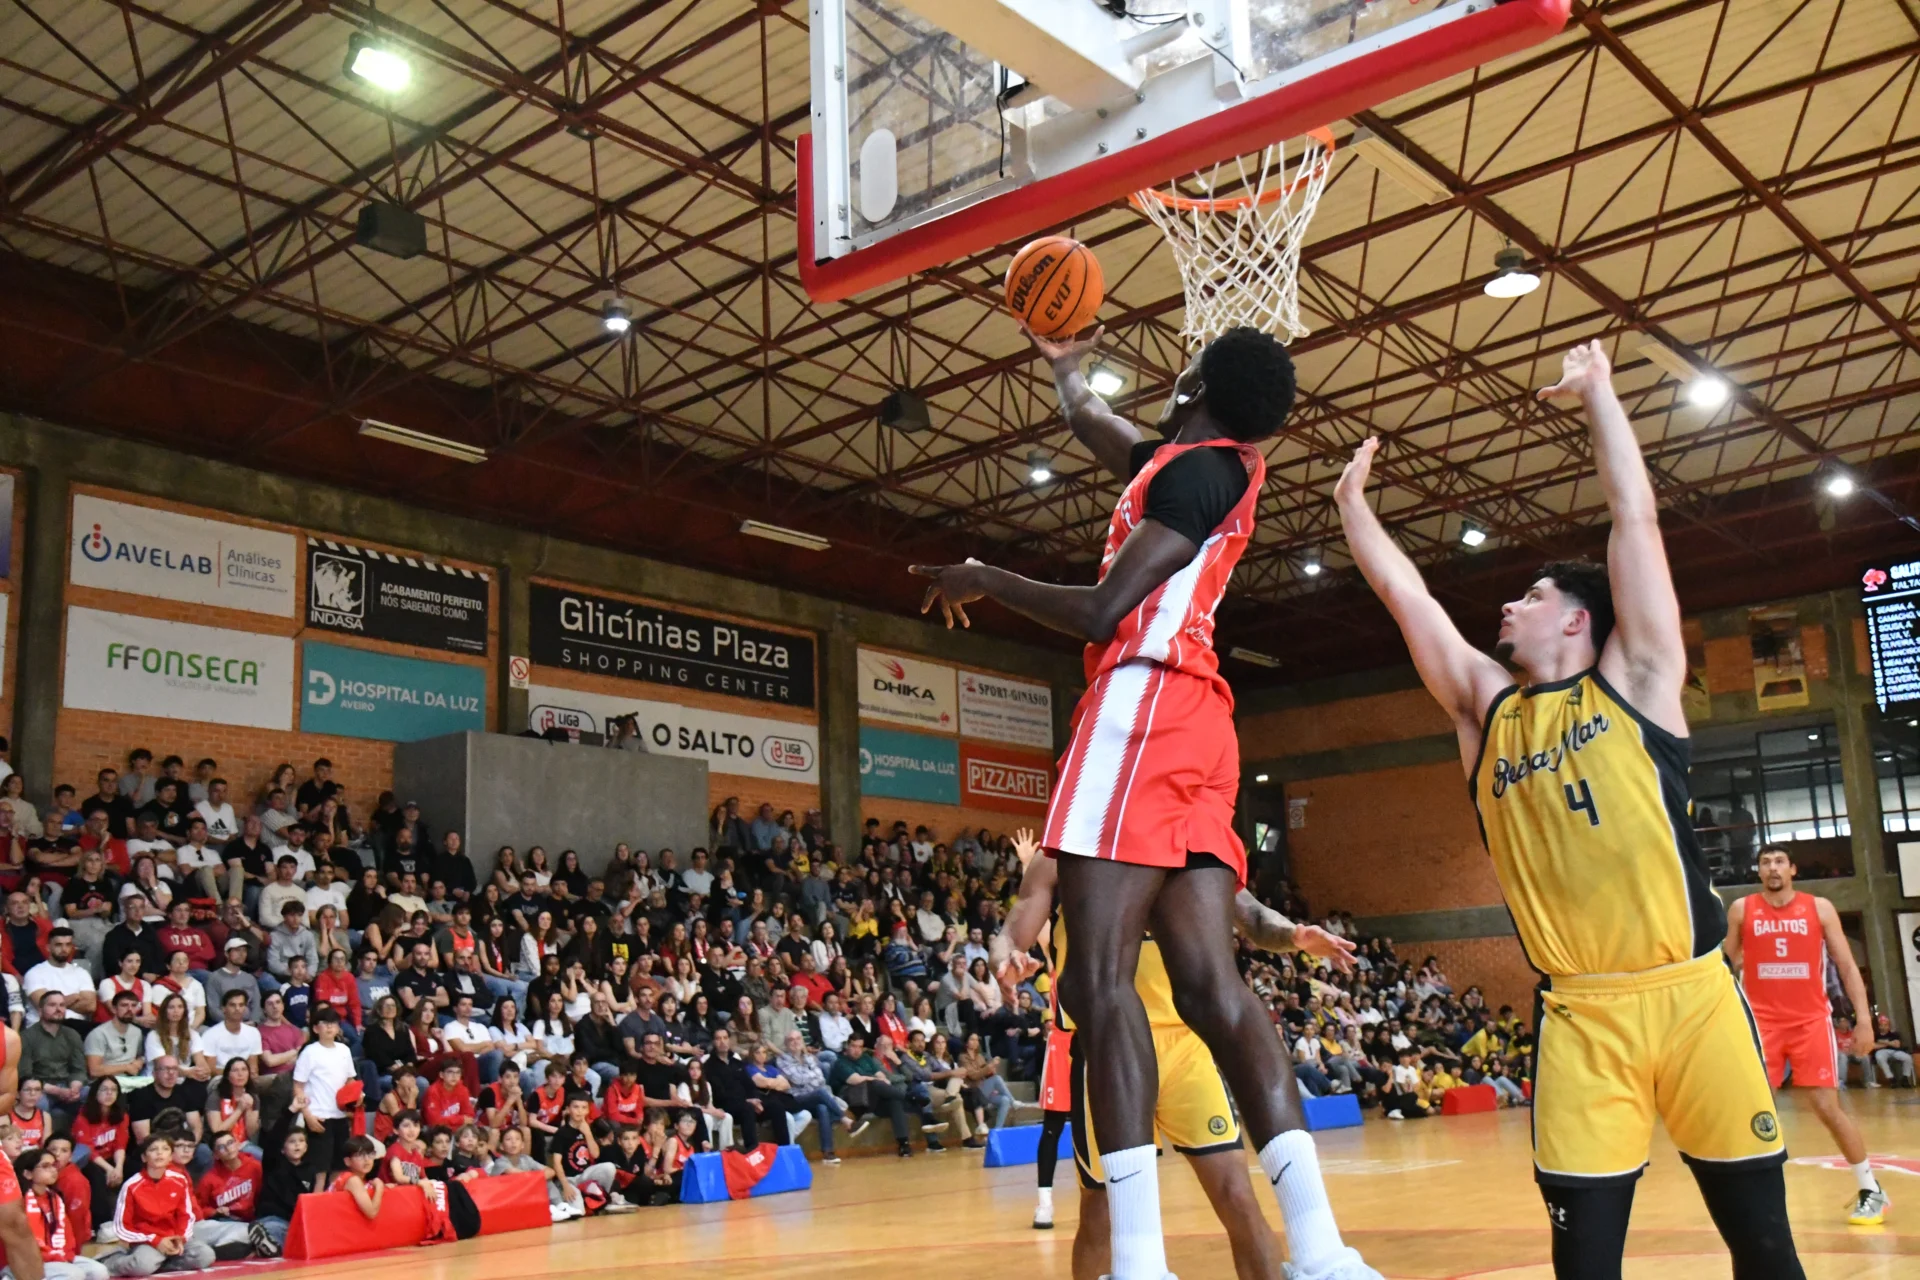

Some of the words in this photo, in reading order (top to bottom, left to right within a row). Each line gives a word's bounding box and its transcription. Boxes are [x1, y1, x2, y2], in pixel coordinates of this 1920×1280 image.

[1011, 254, 1056, 313] Wilson
[115, 542, 213, 575] AVELAB
[227, 549, 282, 570] Análises
[227, 564, 276, 584] Clínicas
[380, 582, 441, 603] ACABAMENTO
[380, 593, 399, 608] NÓS
[400, 599, 441, 616] SABEMOS
[311, 611, 364, 631] INDASA
[559, 596, 701, 652] Glicínias
[713, 626, 789, 669] Plaza
[107, 642, 258, 686] FFONSECA
[562, 648, 689, 683] SHOPPING
[705, 672, 789, 699] CENTER
[340, 679, 420, 705] HOSPITAL
[424, 691, 447, 708] DA
[450, 696, 479, 713] LUZ
[873, 678, 936, 701] DHIKA
[340, 701, 376, 712] AVEIRO
[652, 723, 671, 747] O
[678, 726, 755, 758] SALTO
[873, 753, 921, 771] HOSPITAL
[922, 760, 936, 773] DA
[937, 761, 956, 776] LUZ
[970, 765, 1046, 797] PIZZARTE
[1563, 778, 1600, 826] 4
[1753, 918, 1808, 936] GALITOS
[1775, 938, 1788, 957] 5
[1760, 964, 1804, 975] PIZZARTE
[1047, 1087, 1054, 1104] 3
[216, 1179, 253, 1207] GALITOS
